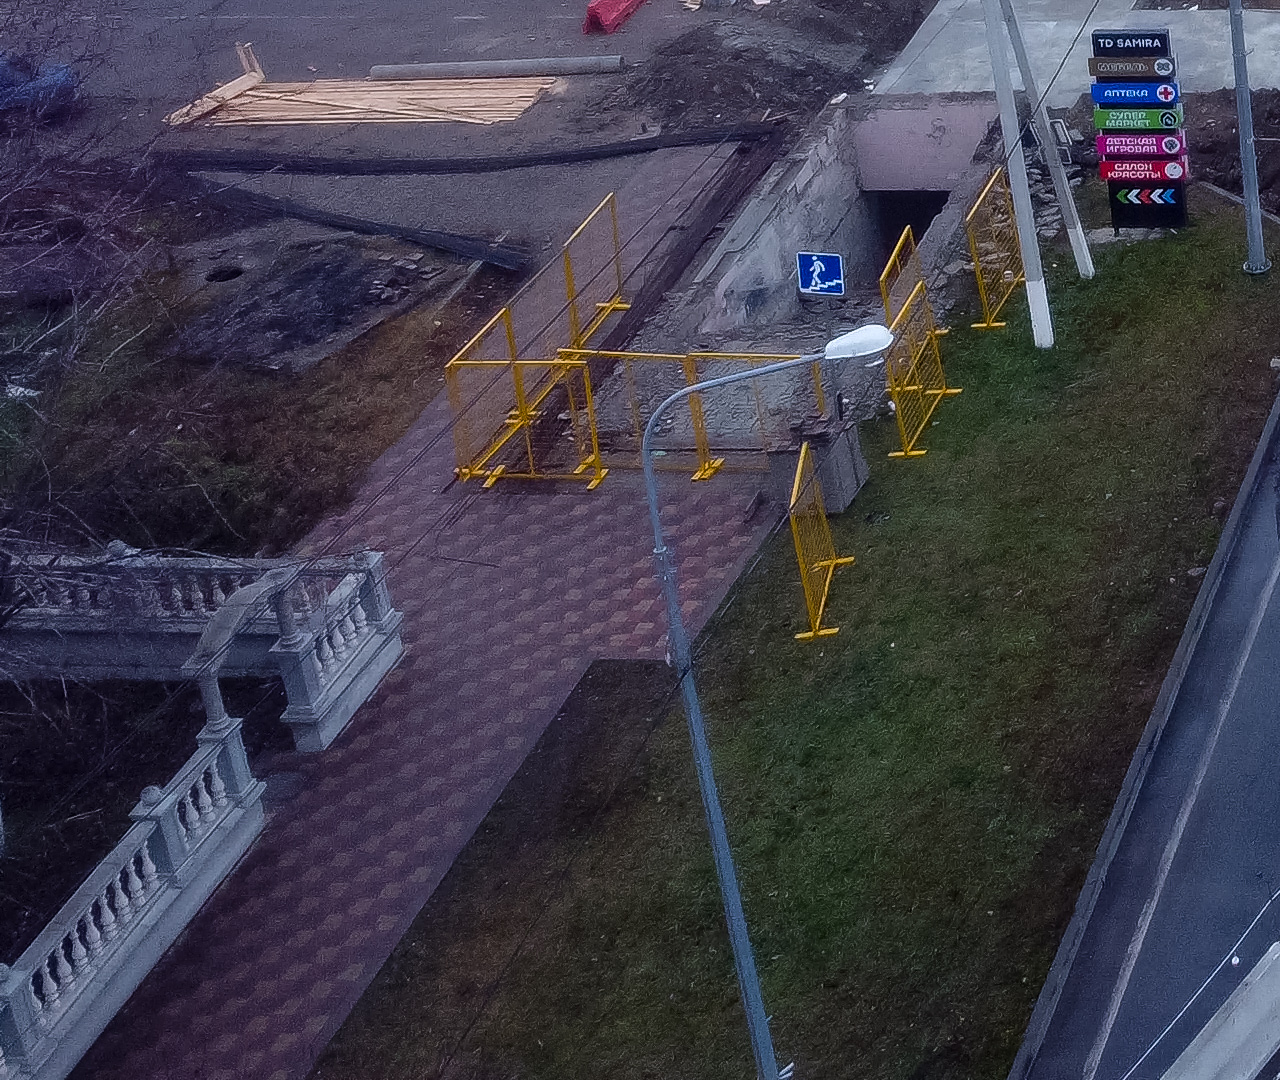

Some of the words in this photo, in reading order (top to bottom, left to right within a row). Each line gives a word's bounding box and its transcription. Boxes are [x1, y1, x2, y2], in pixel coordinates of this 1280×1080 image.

[1098, 39, 1113, 48] TD
[1117, 39, 1161, 48] SAMIRA
[1104, 89, 1149, 97] АПТЕКА
[1105, 137, 1156, 145] ДЕТСКАЯ
[1106, 145, 1158, 153] ИГРОВАЯ
[1107, 170, 1162, 179] КРАСОТЫ
